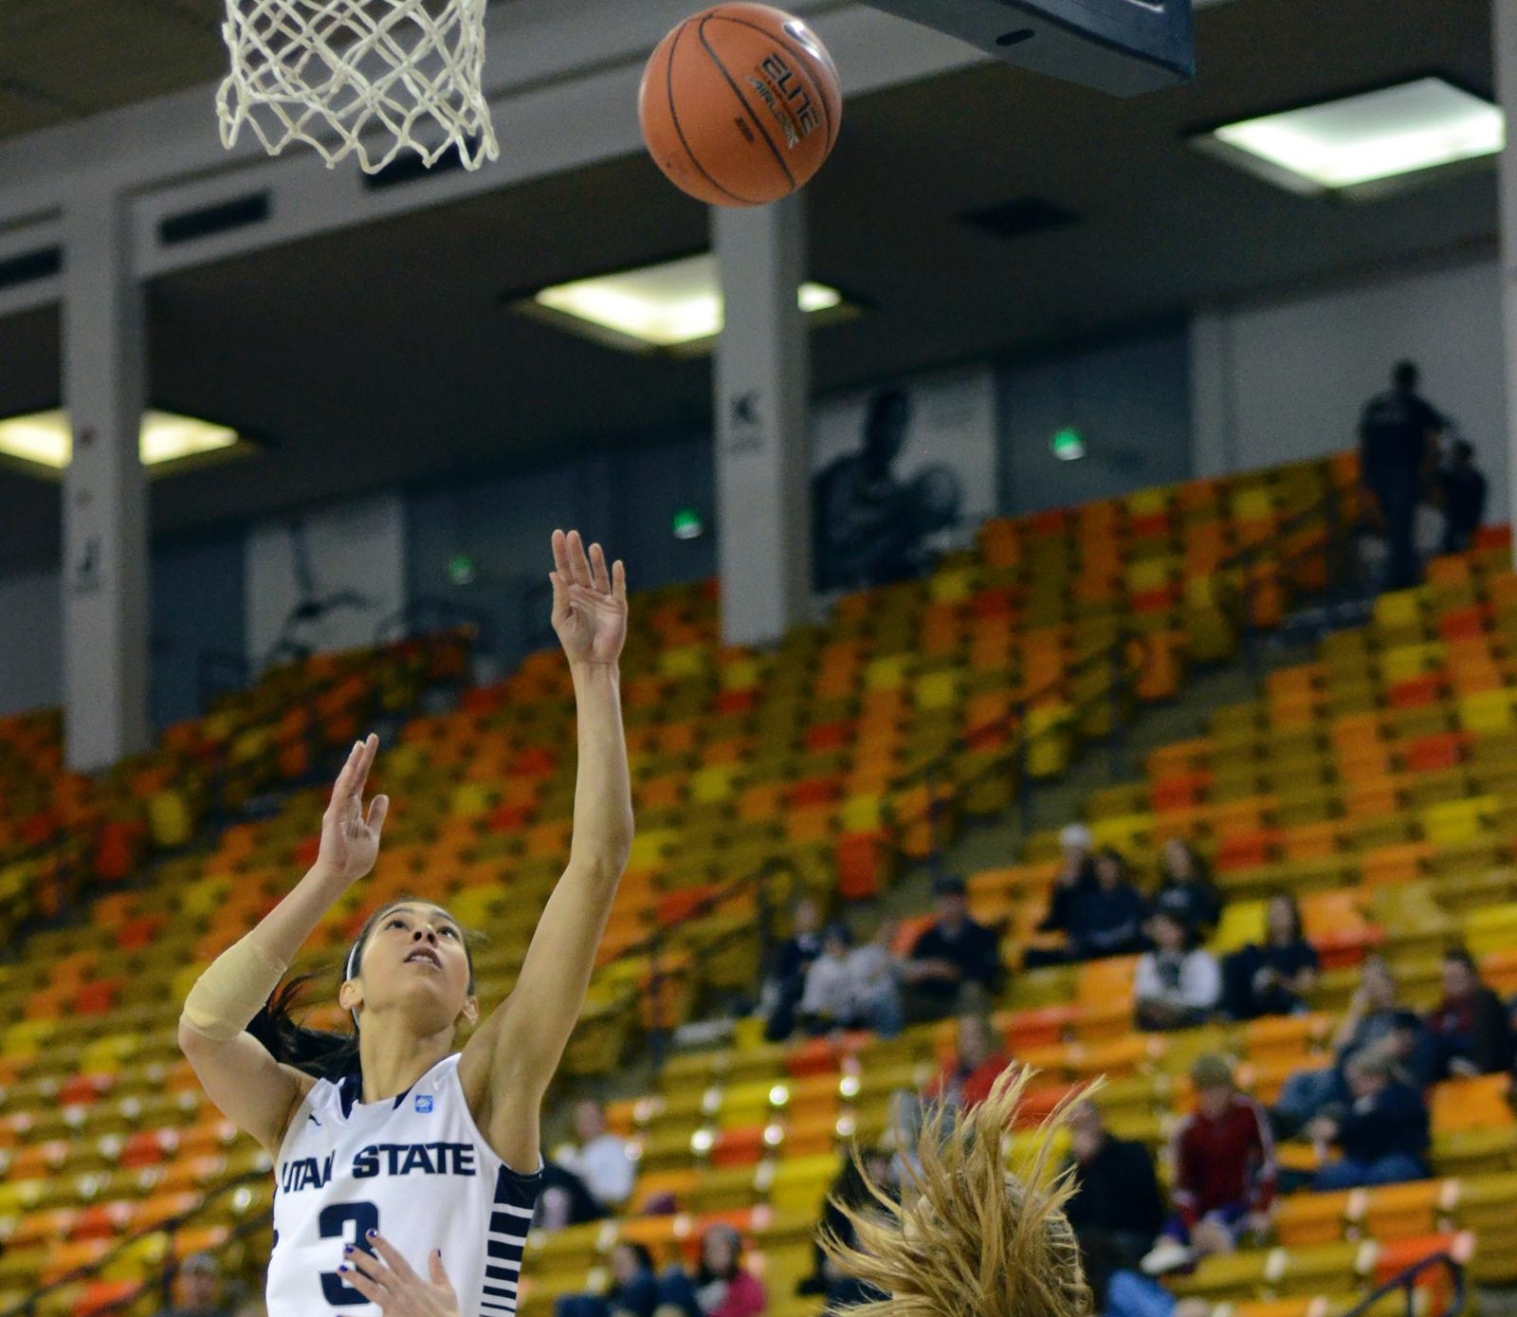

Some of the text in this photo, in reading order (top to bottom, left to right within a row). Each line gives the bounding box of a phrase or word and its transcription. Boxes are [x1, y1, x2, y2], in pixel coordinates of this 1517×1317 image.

[762, 53, 819, 134] ELITE
[352, 1142, 477, 1179] STATE
[318, 1201, 379, 1306] 3
